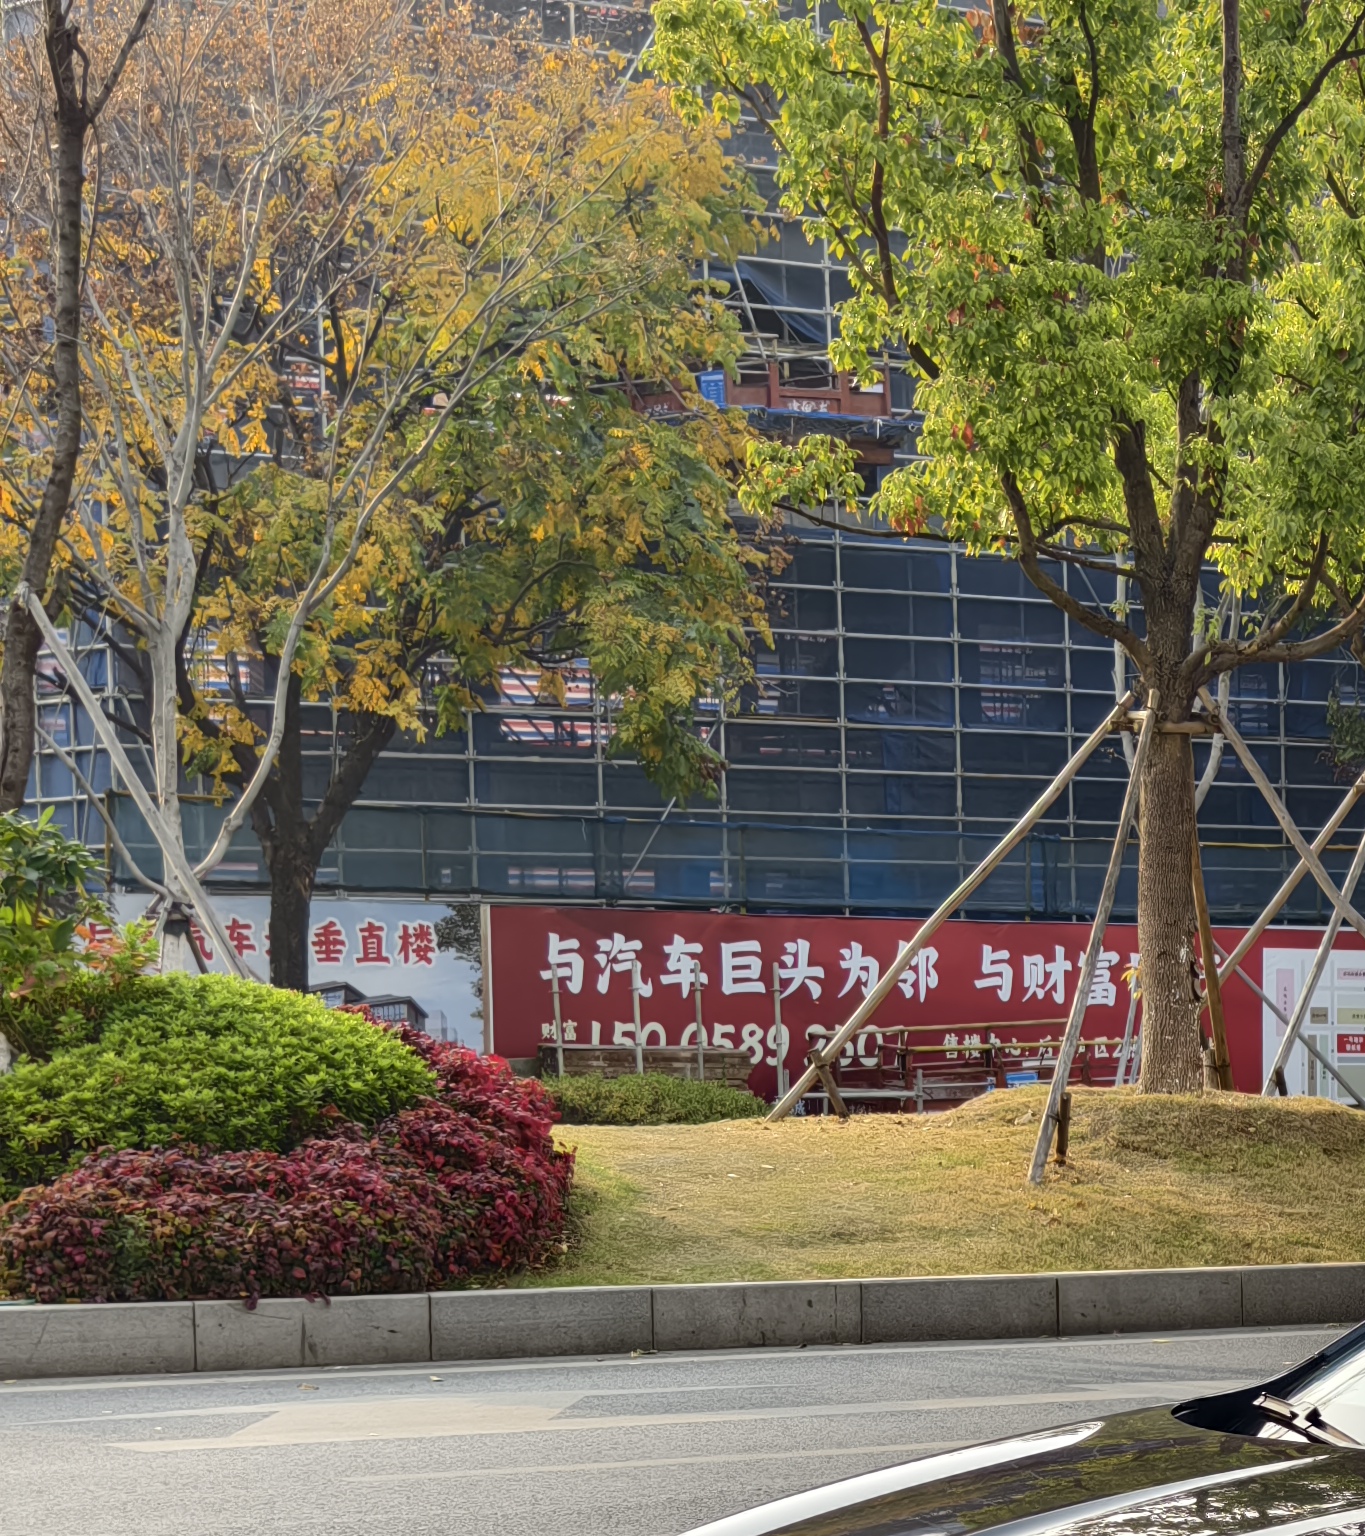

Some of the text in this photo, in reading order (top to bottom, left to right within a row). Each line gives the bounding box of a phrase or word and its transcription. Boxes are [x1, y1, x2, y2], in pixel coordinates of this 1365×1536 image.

[539, 931, 940, 1004] 与汽车巨头为邻
[541, 1018, 578, 1042] 财富
